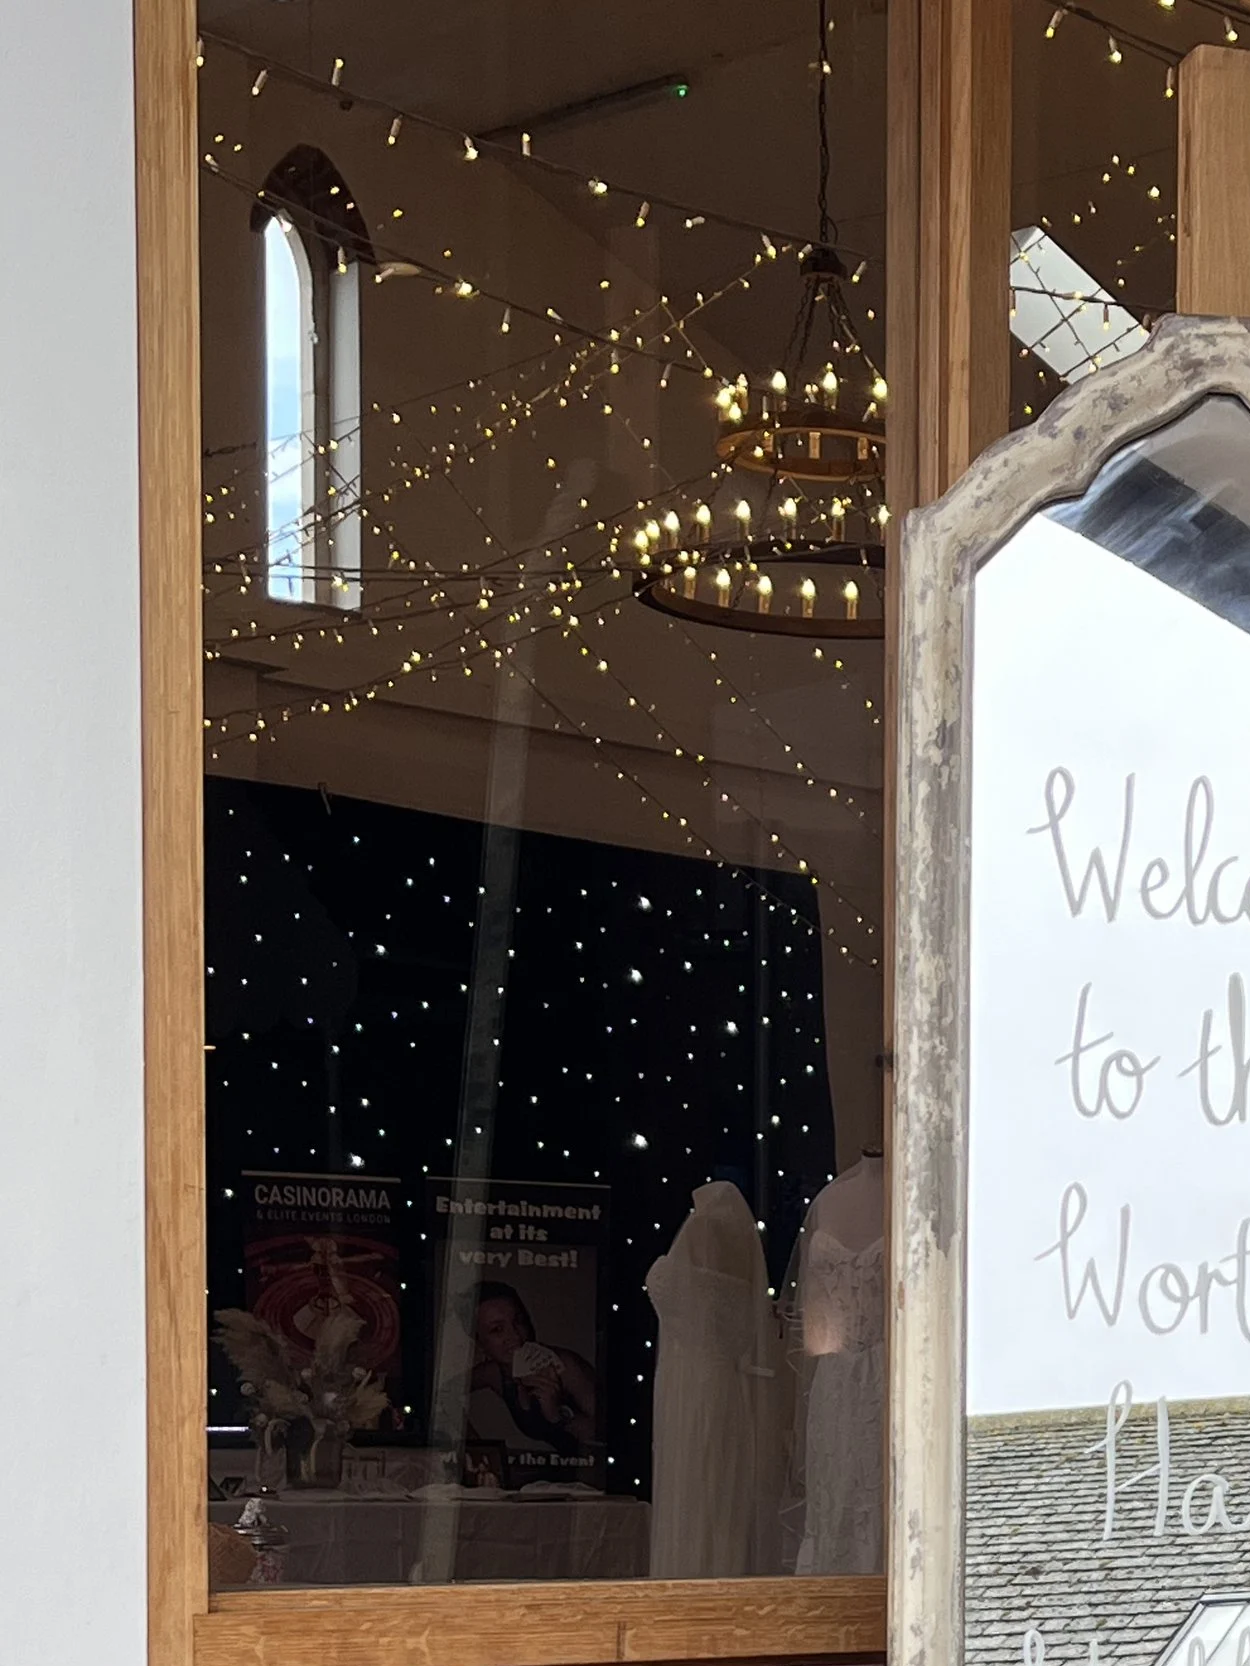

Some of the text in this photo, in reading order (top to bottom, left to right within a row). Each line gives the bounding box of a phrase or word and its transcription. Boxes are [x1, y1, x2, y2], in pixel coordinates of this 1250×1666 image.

[1054, 981, 1161, 1120] to
[254, 1183, 391, 1210] CASINORAMA
[435, 1195, 602, 1221] Entertainment
[266, 1209, 298, 1222] ELITE
[301, 1210, 343, 1223] EVENTS
[347, 1212, 391, 1225] LONDON
[490, 1224, 549, 1241] at its
[459, 1247, 579, 1269] very Best!
